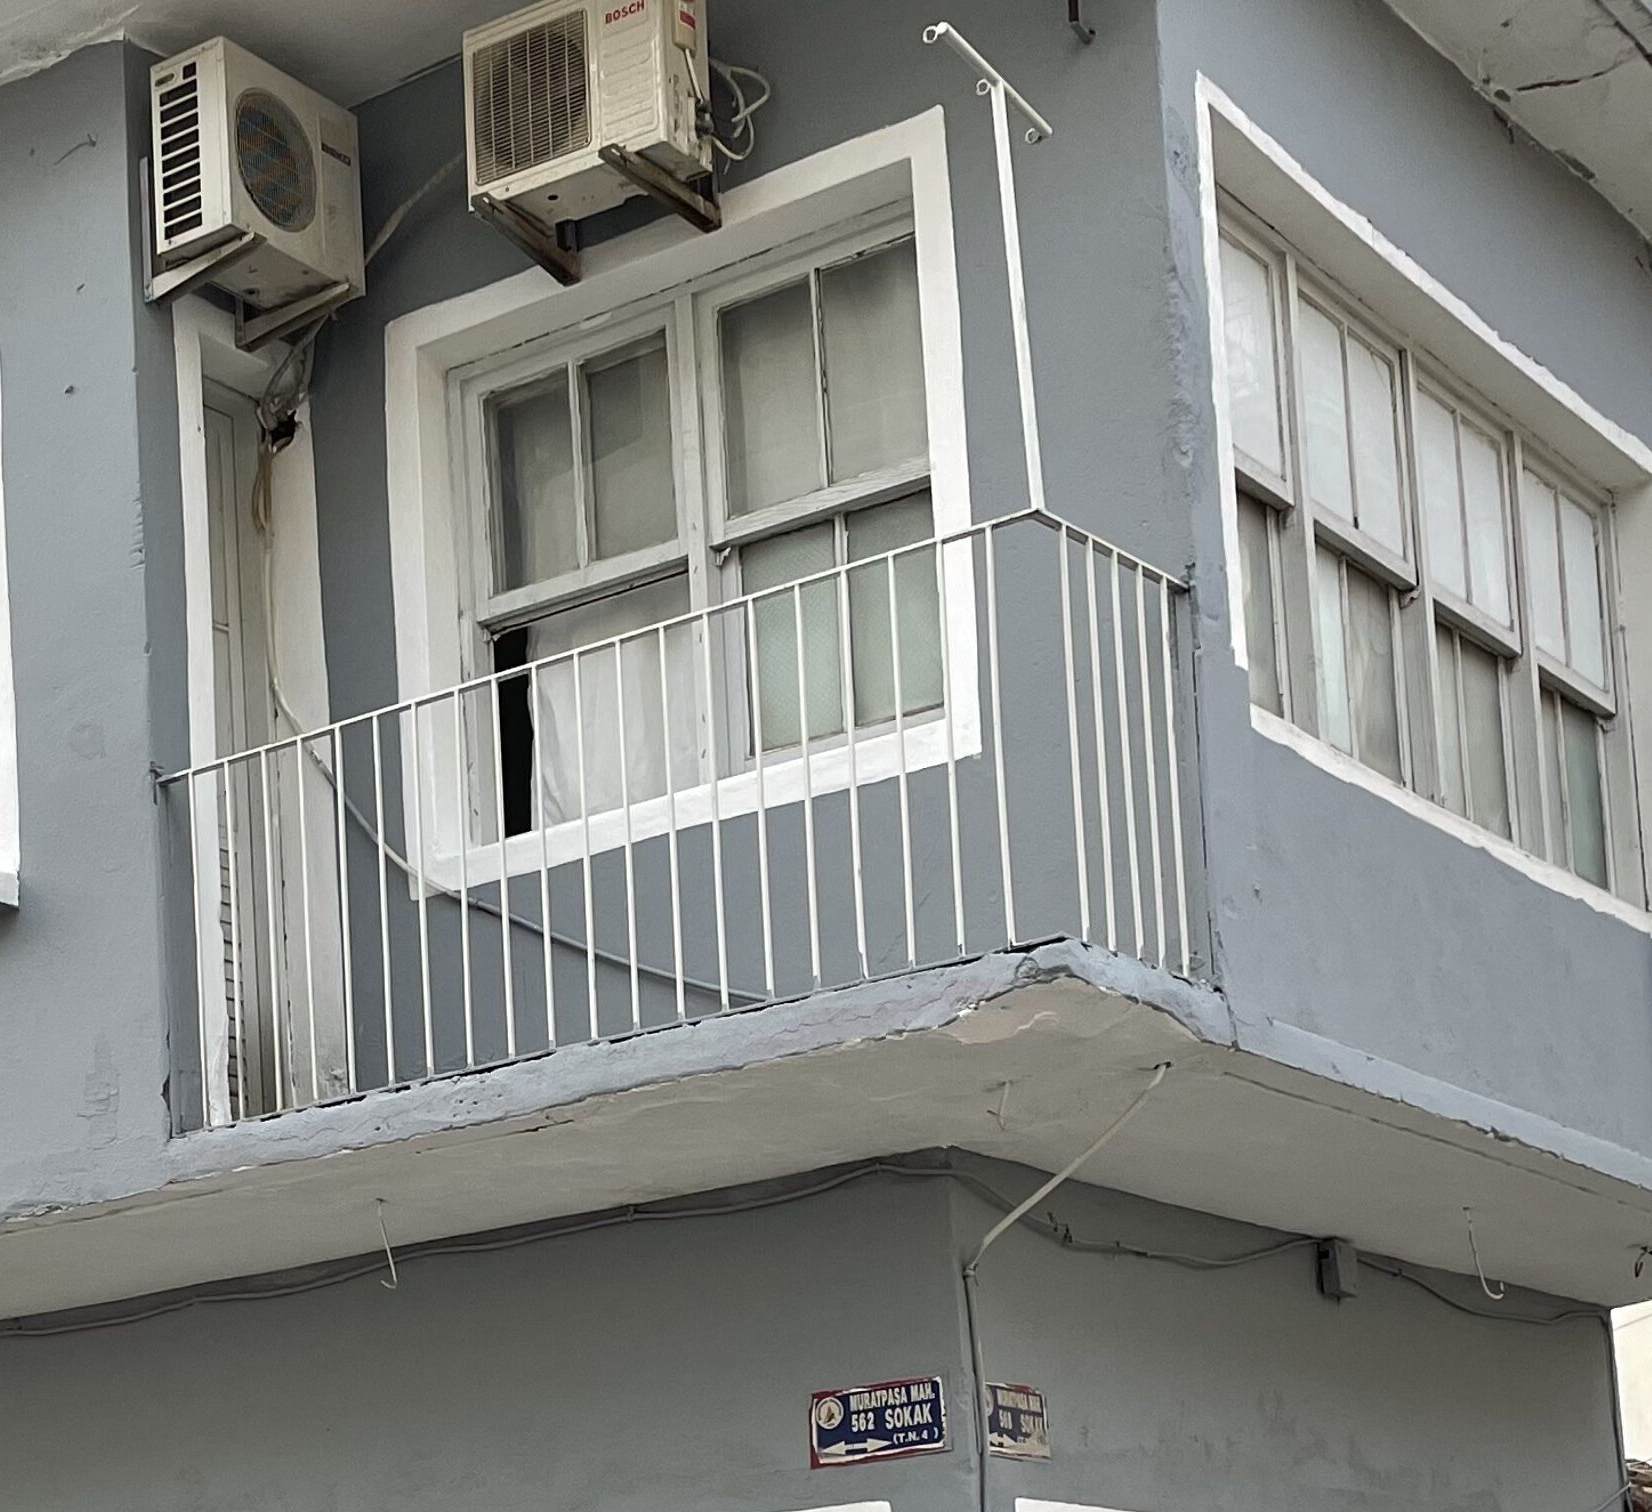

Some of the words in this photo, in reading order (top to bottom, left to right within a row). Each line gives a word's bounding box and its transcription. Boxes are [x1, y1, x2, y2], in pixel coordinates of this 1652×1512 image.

[605, 0, 645, 24] BOSCH
[851, 1411, 875, 1432] 562
[885, 1402, 933, 1430] SOKAK
